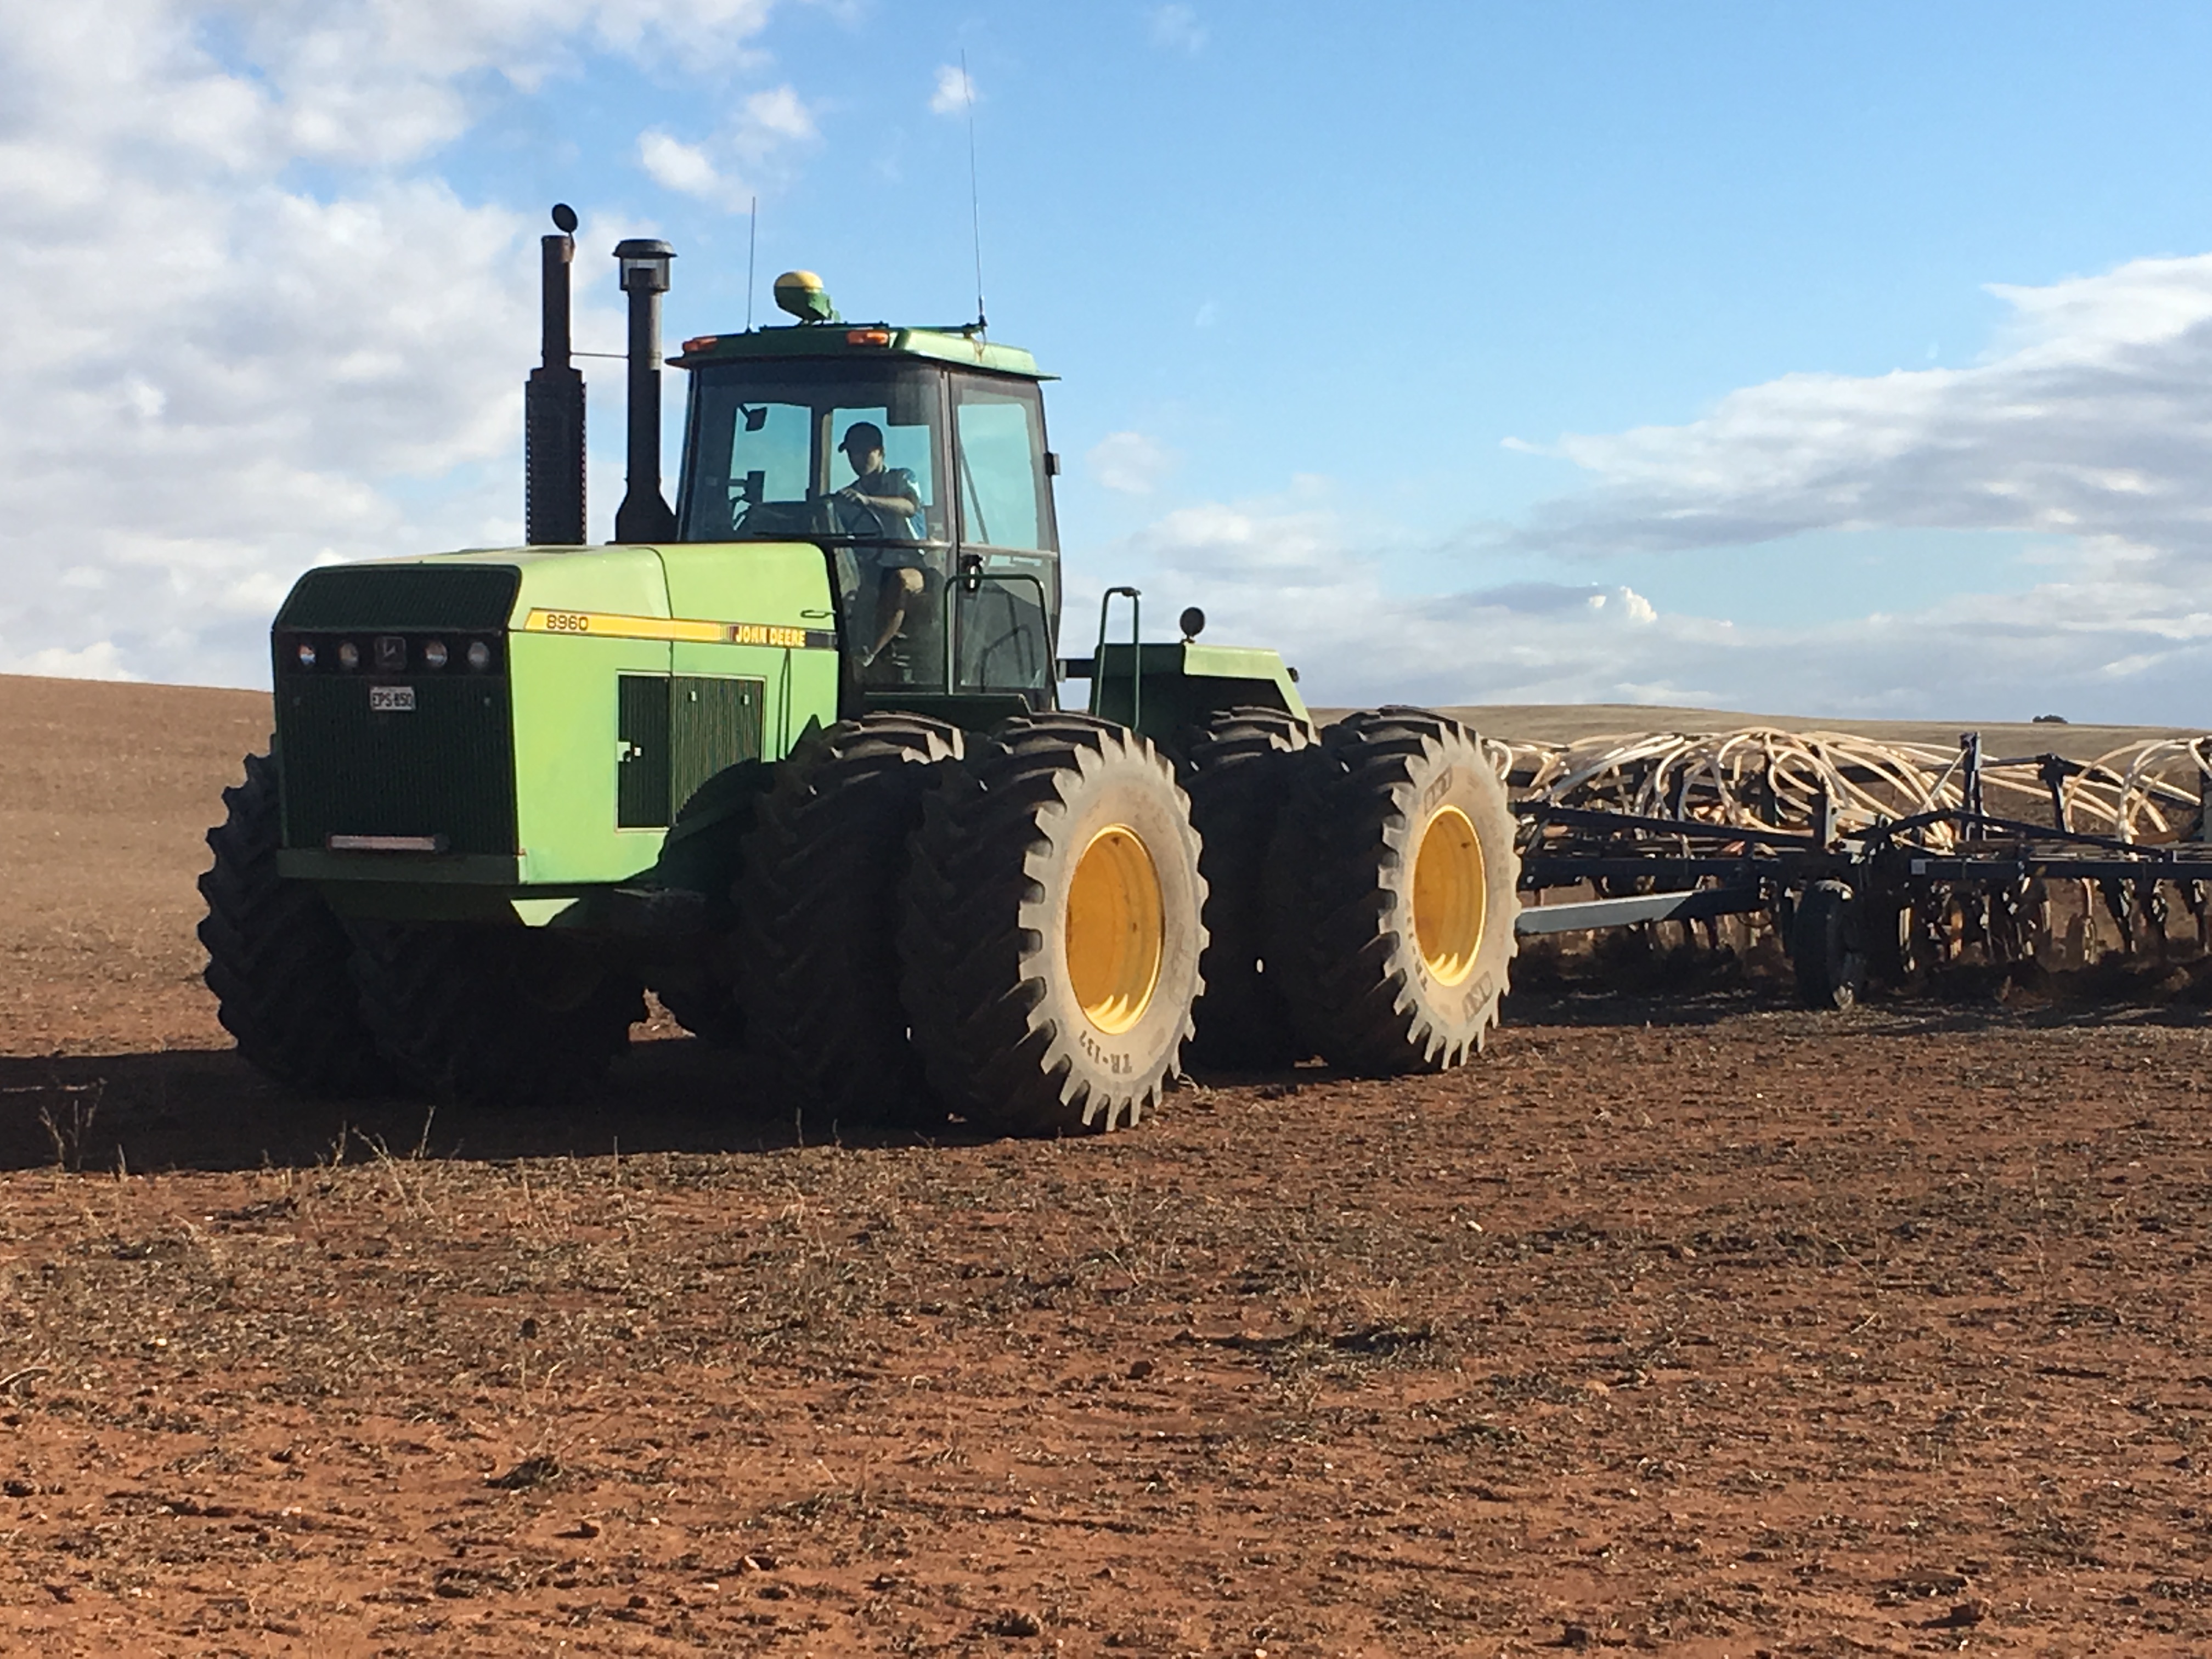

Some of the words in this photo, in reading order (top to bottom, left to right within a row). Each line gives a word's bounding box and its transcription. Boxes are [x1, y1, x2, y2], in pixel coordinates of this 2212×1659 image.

[546, 614, 589, 631] 8960
[736, 625, 768, 644] JOHN
[769, 627, 806, 647] DEERE
